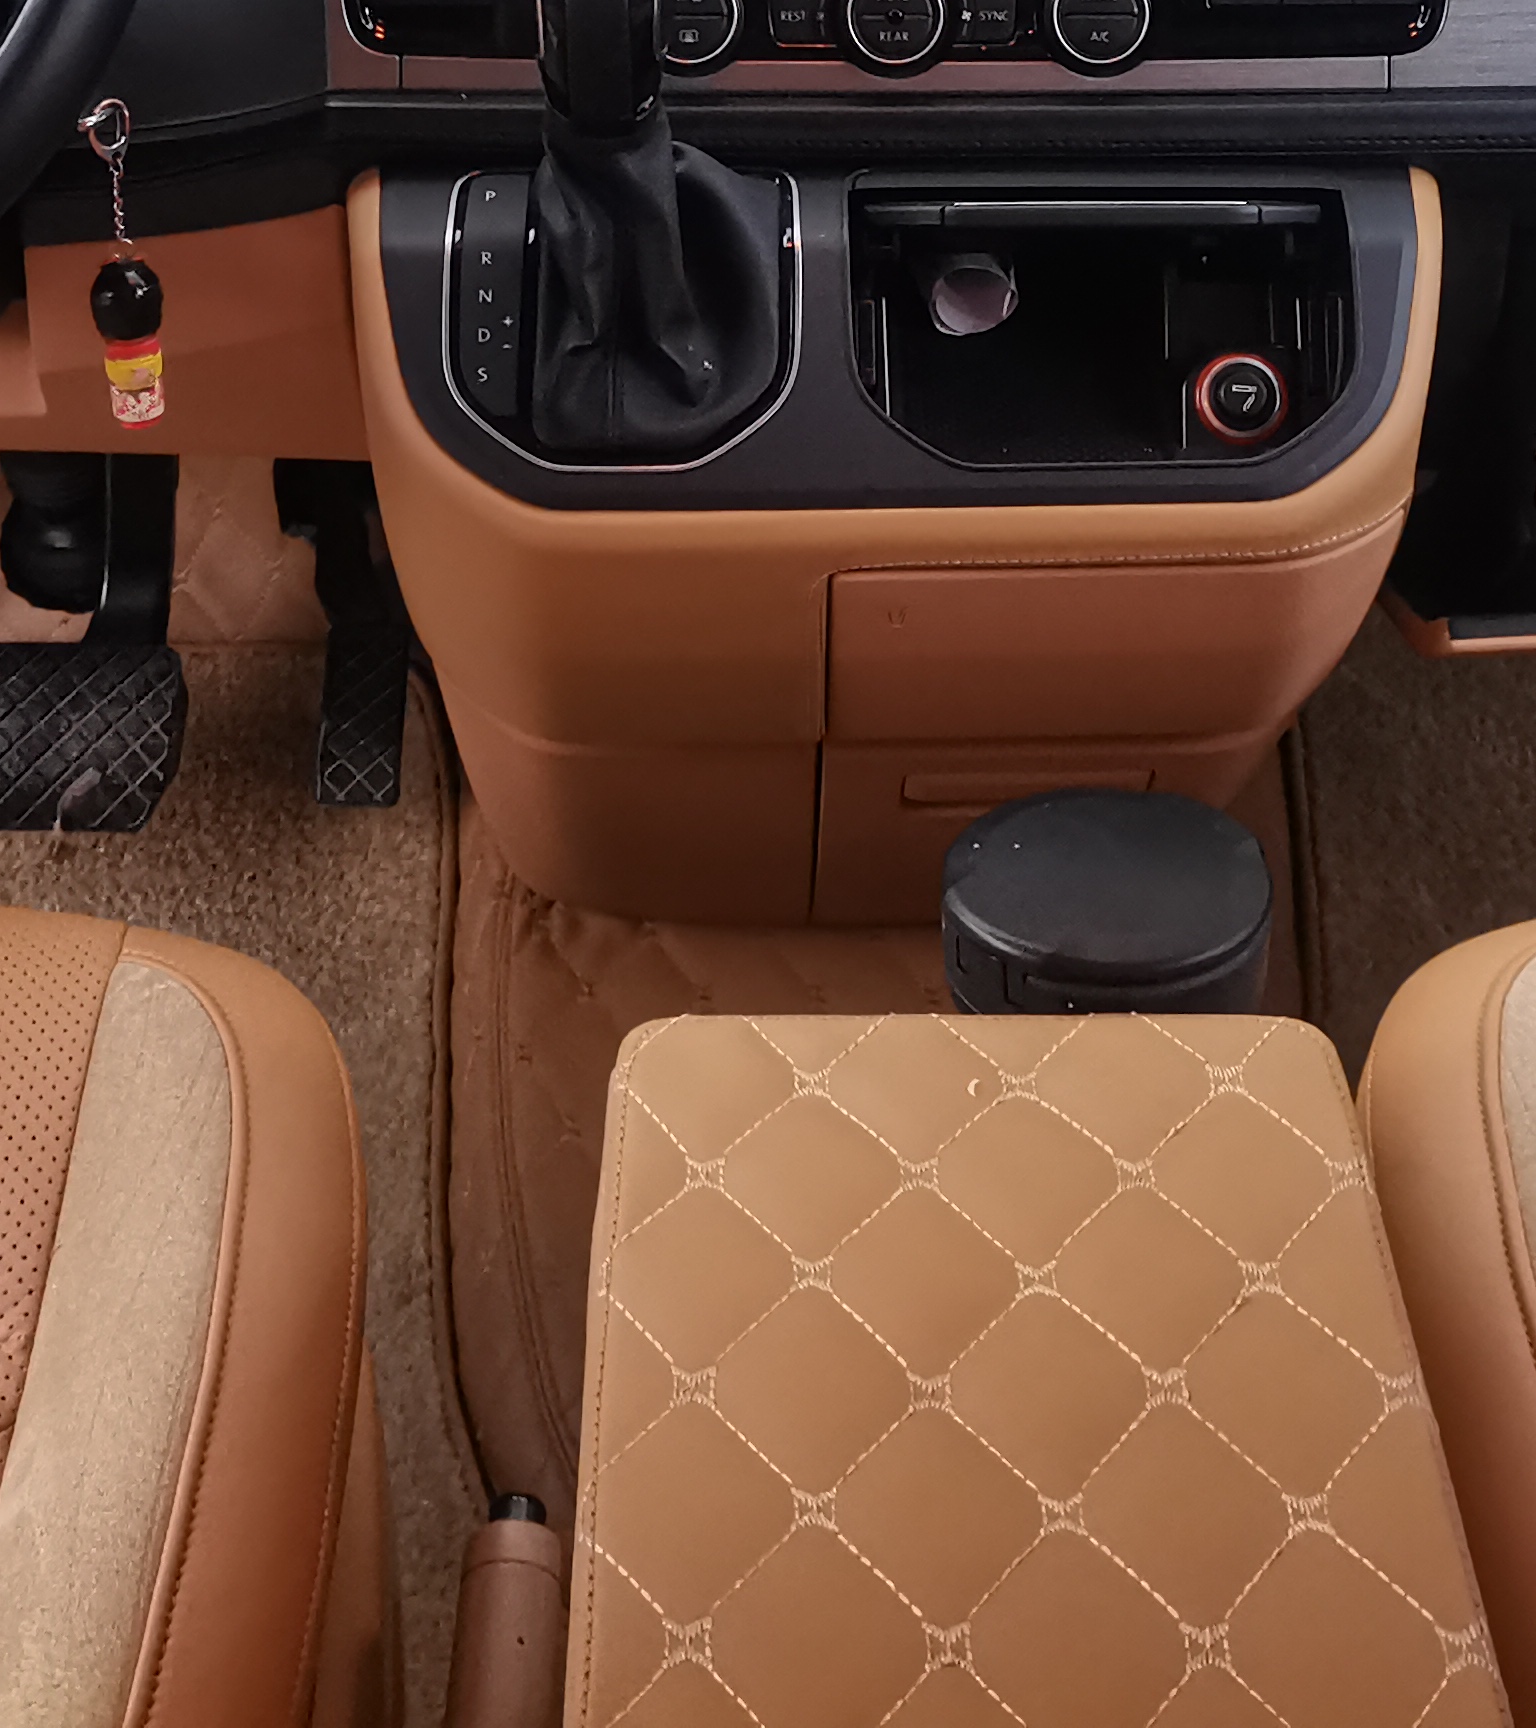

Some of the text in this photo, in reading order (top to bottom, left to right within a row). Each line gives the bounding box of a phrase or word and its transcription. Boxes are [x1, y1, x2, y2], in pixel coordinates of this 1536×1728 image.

[780, 10, 806, 22] REST
[979, 10, 1009, 22] SYNC
[879, 31, 909, 42] REAR
[485, 190, 497, 201] P
[481, 251, 492, 265] R
[478, 289, 493, 303] N
[478, 328, 491, 343] D
[477, 367, 488, 382] S
